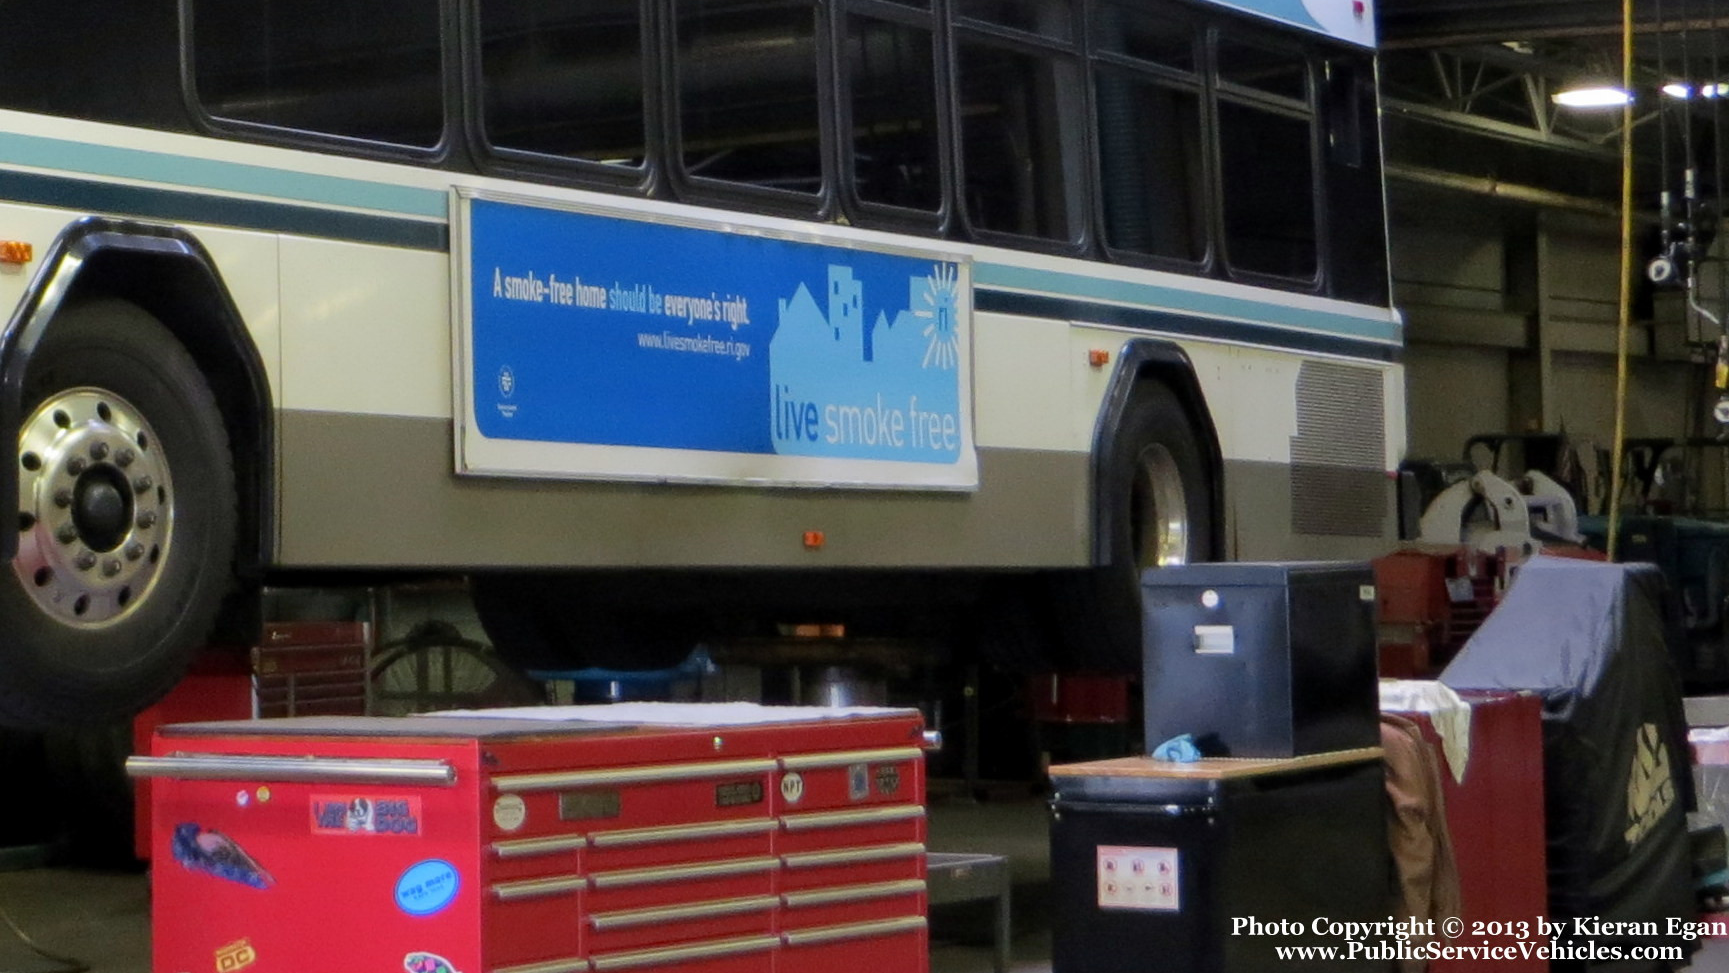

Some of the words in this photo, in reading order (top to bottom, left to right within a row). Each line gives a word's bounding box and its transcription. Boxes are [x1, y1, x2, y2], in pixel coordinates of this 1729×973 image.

[493, 266, 503, 298] A
[504, 270, 574, 306] smoke-free
[575, 275, 607, 309] home
[609, 280, 647, 313] should
[648, 284, 663, 314] be
[664, 291, 721, 325] everyone's
[722, 294, 750, 331] right.
[637, 331, 751, 361] www.livesmokefree.ri.gov
[775, 384, 819, 441] live
[825, 392, 905, 447] smoke
[909, 395, 956, 450] free
[221, 948, 251, 970] DC
